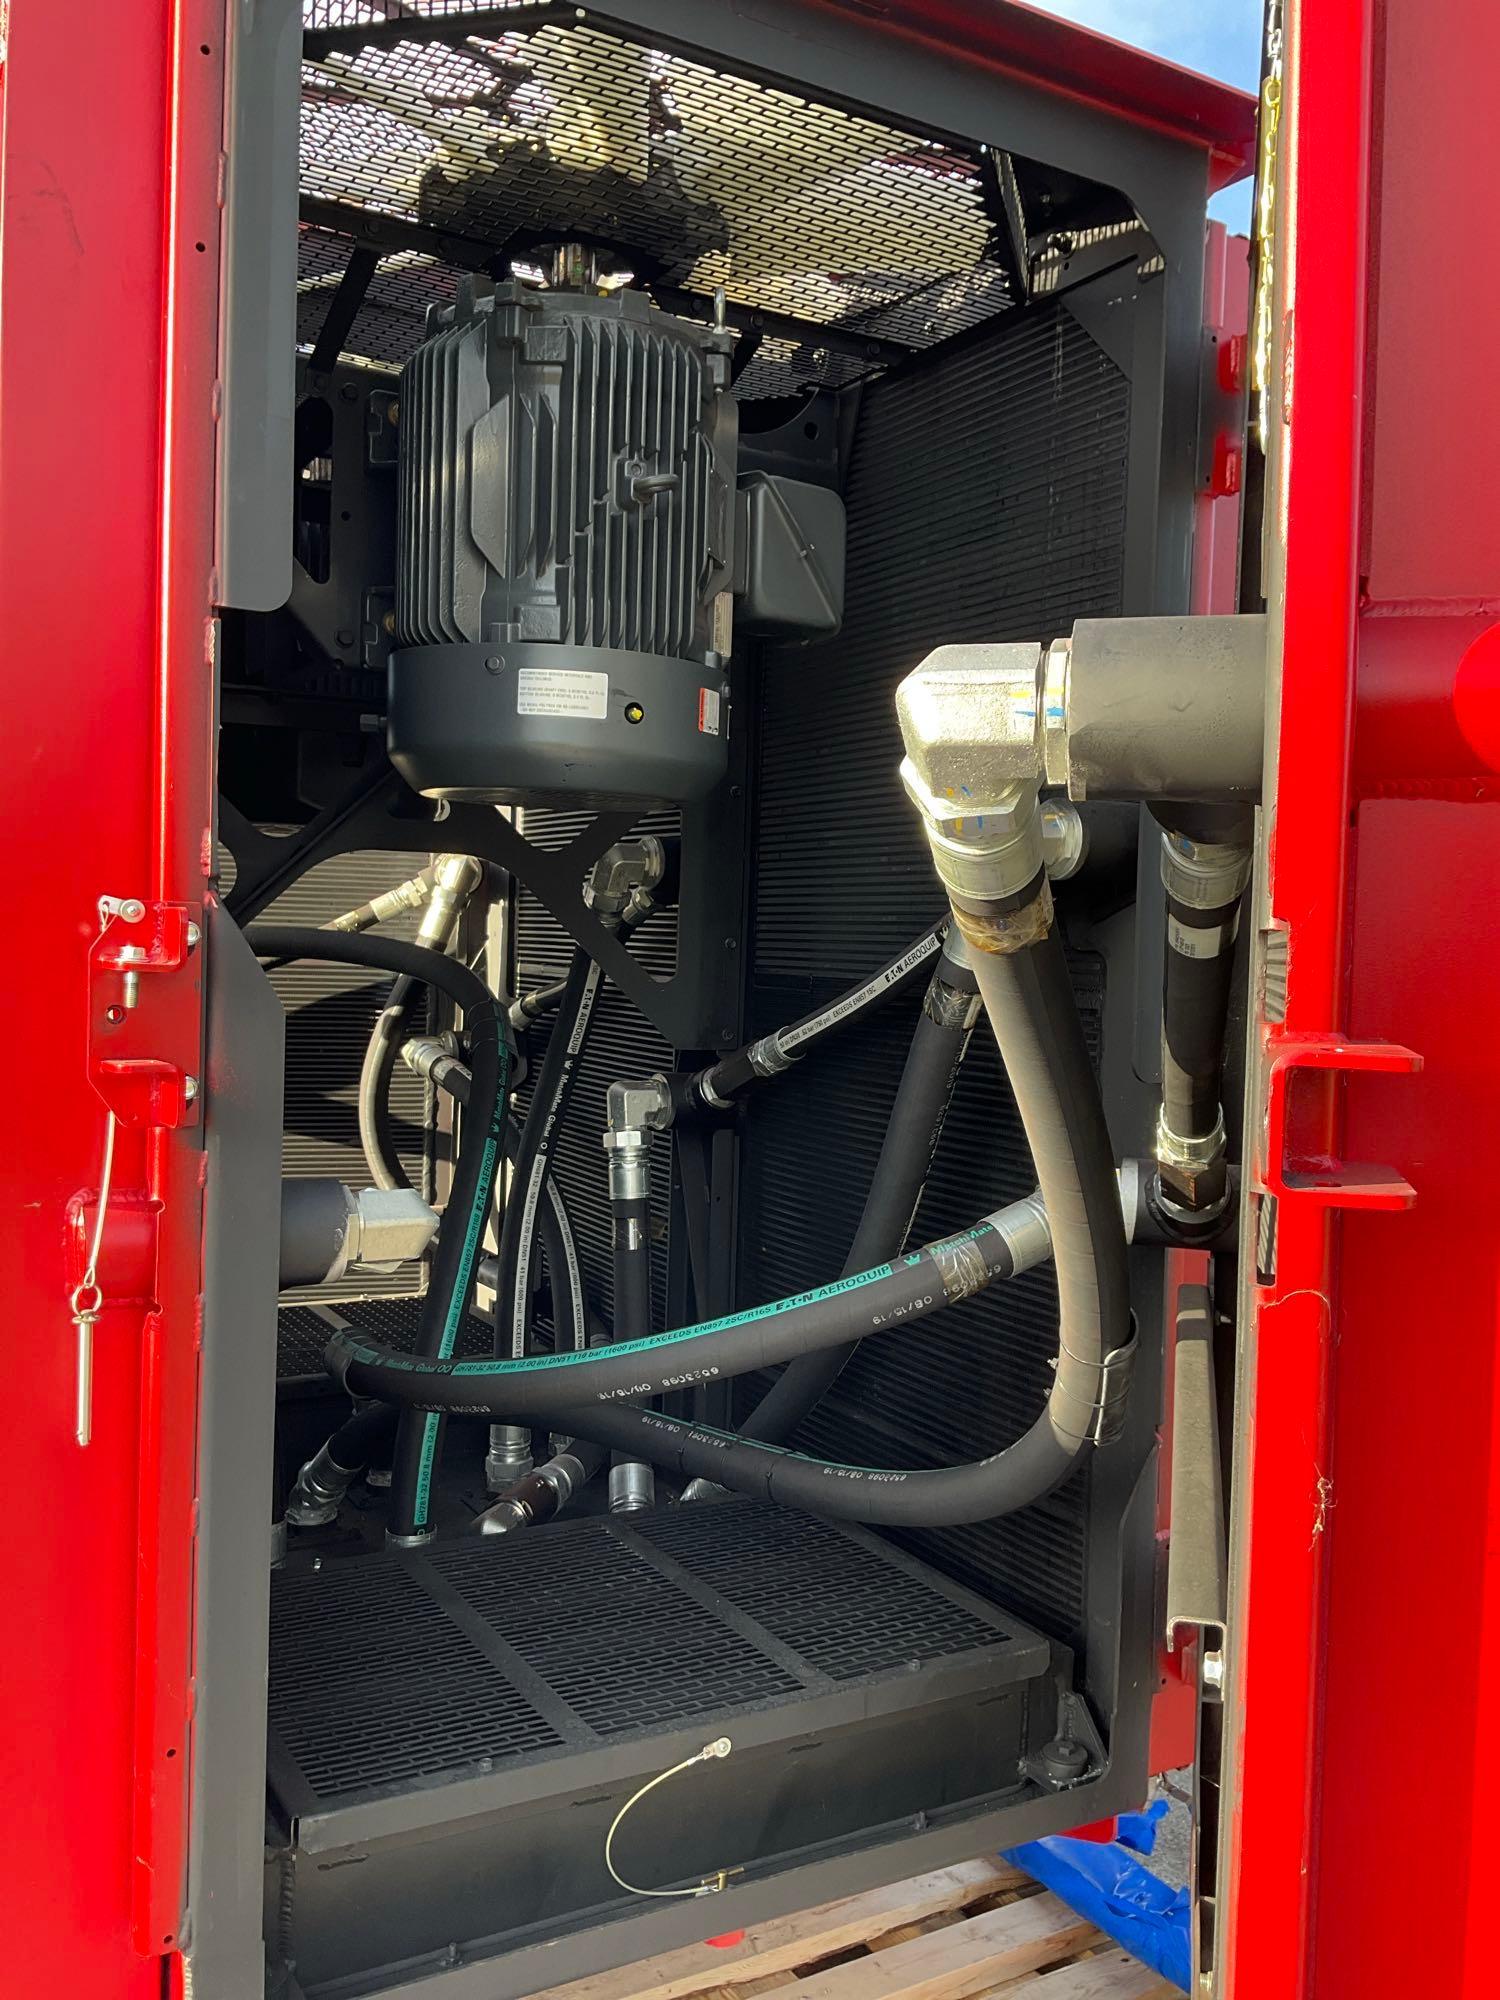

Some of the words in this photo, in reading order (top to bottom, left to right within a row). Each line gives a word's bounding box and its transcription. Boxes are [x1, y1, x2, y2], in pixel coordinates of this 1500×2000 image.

[832, 1001, 853, 1018] EXCEEDS
[904, 936, 936, 968] AEROQUIP
[570, 1011, 586, 1053] AEROQUIP
[543, 1114, 556, 1137] Global
[454, 1274, 467, 1309] EXCEEDS
[483, 1138, 497, 1185] AEROQUIP
[818, 1265, 890, 1298] AEROQUIP
[575, 1303, 583, 1337] EXCEEDS
[872, 1295, 933, 1326] 08/15/19
[515, 1319, 523, 1350] EXCEEDS
[548, 1355, 571, 1365] DN51
[588, 1350, 602, 1358] bar
[604, 1345, 627, 1356] (1600
[649, 1328, 692, 1345] EXCEEDS
[694, 1320, 724, 1334] EN857
[725, 1306, 772, 1326] 2SC/R16S
[425, 1447, 433, 1462] mm
